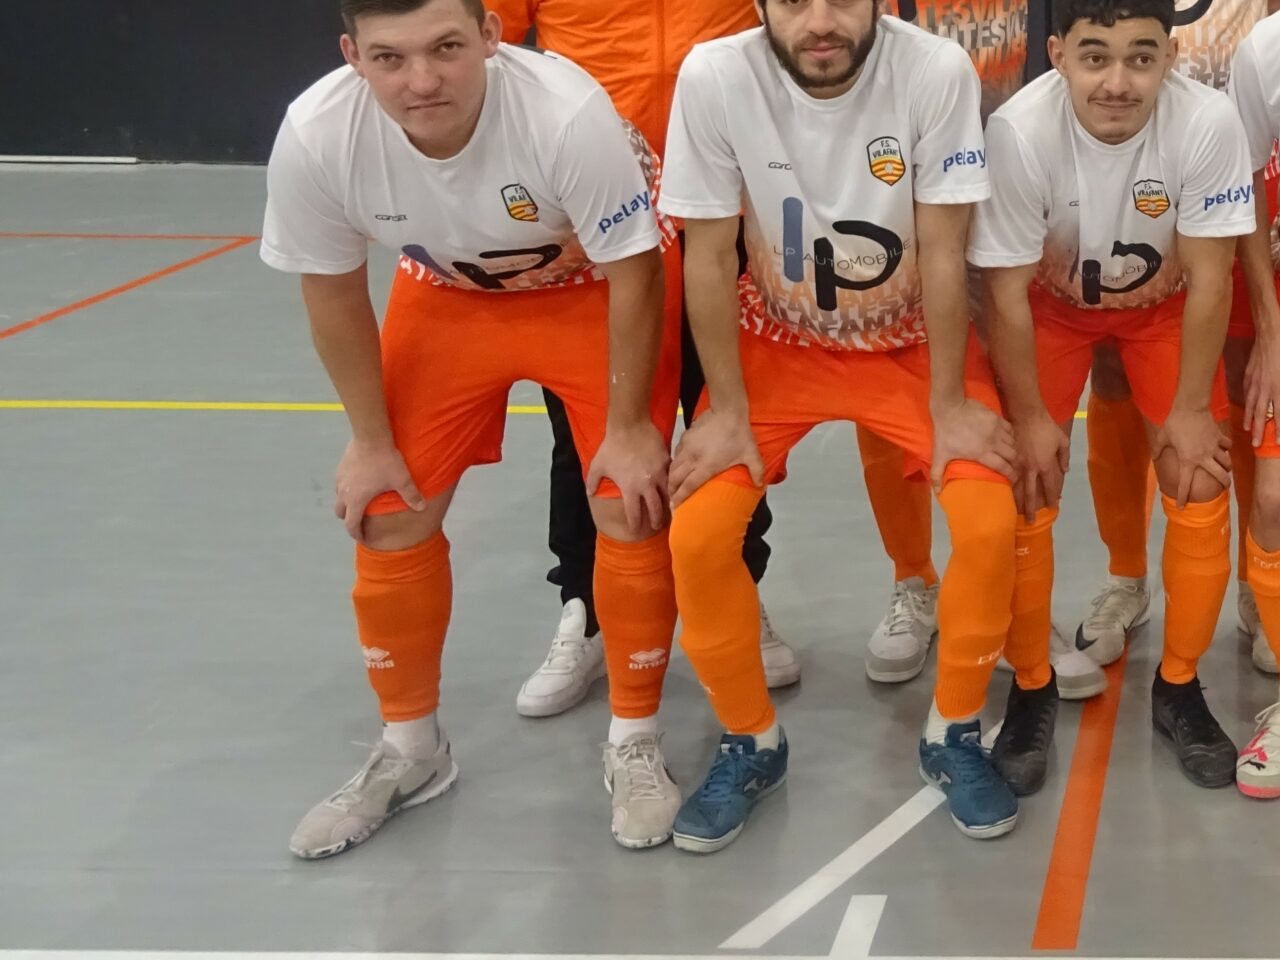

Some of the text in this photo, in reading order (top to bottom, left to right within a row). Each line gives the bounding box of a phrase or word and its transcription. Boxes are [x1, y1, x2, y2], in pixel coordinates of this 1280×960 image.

[943, 146, 987, 173] pelay
[598, 190, 651, 234] pelay
[1203, 184, 1255, 212] pelay
[802, 236, 912, 271] AUTOMOBILE
